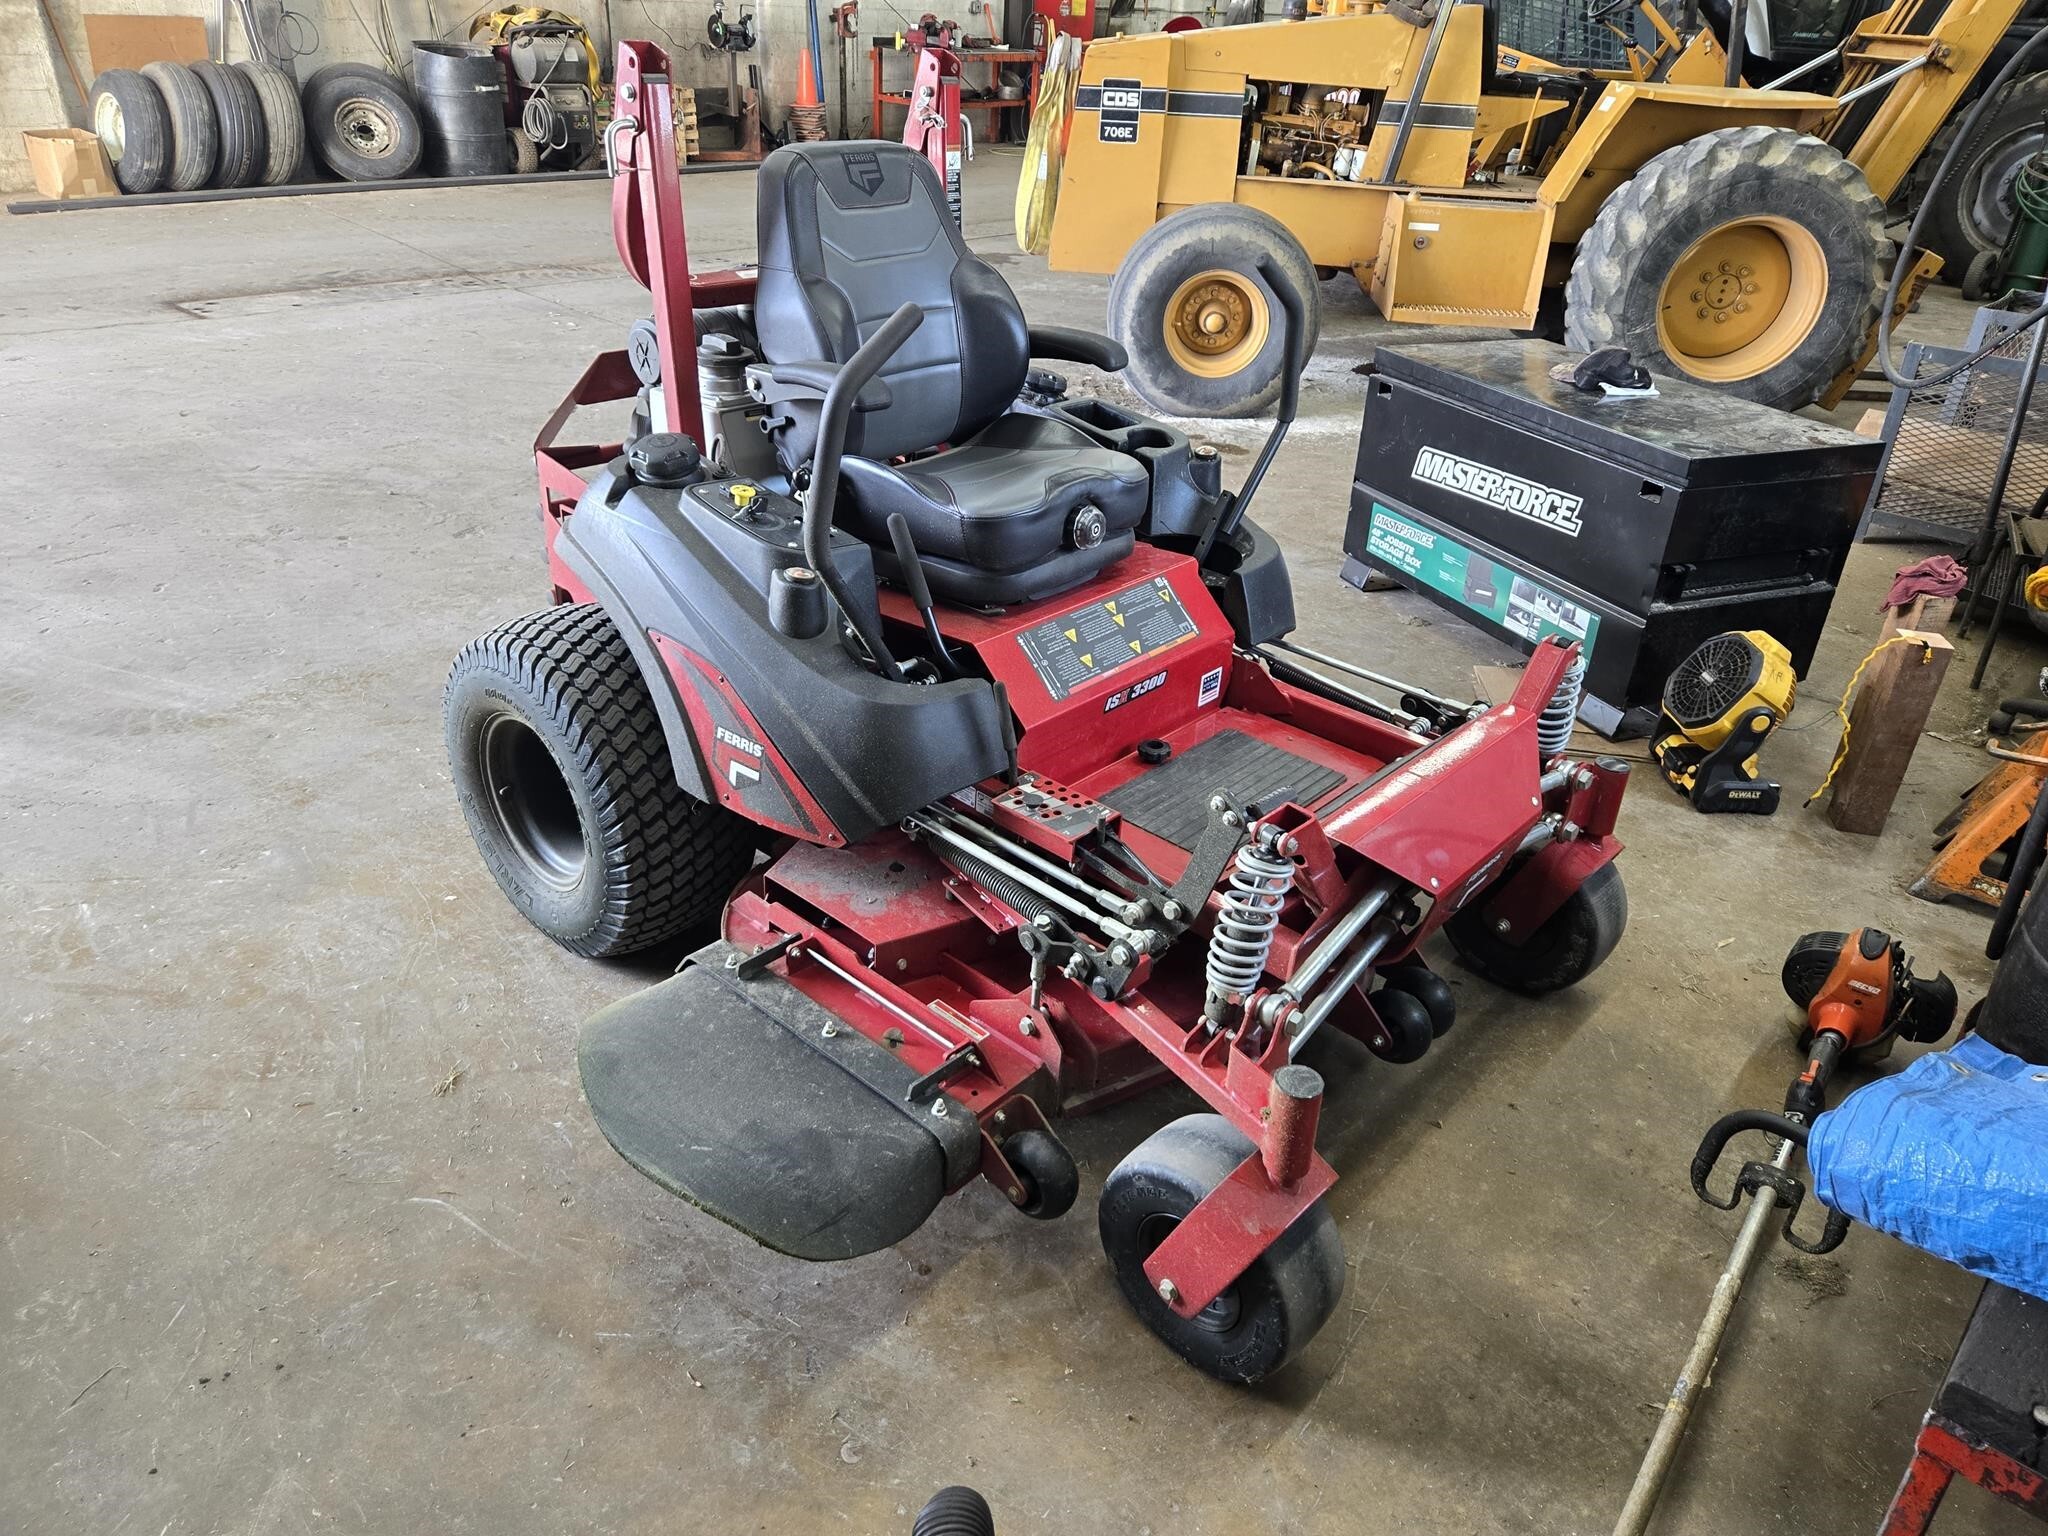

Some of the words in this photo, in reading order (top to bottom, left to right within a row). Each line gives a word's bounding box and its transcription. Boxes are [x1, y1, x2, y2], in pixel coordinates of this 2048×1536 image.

[1103, 91, 1138, 107] CDS
[1103, 126, 1133, 138] 706E
[844, 153, 875, 161] FERRIS
[1369, 535, 1405, 560] STORAGE
[1404, 554, 1422, 568] BOX
[1384, 534, 1415, 555] JOBSITE
[1105, 688, 1130, 711] ISX
[1131, 671, 1167, 698] 3300
[716, 726, 763, 757] FERRIS
